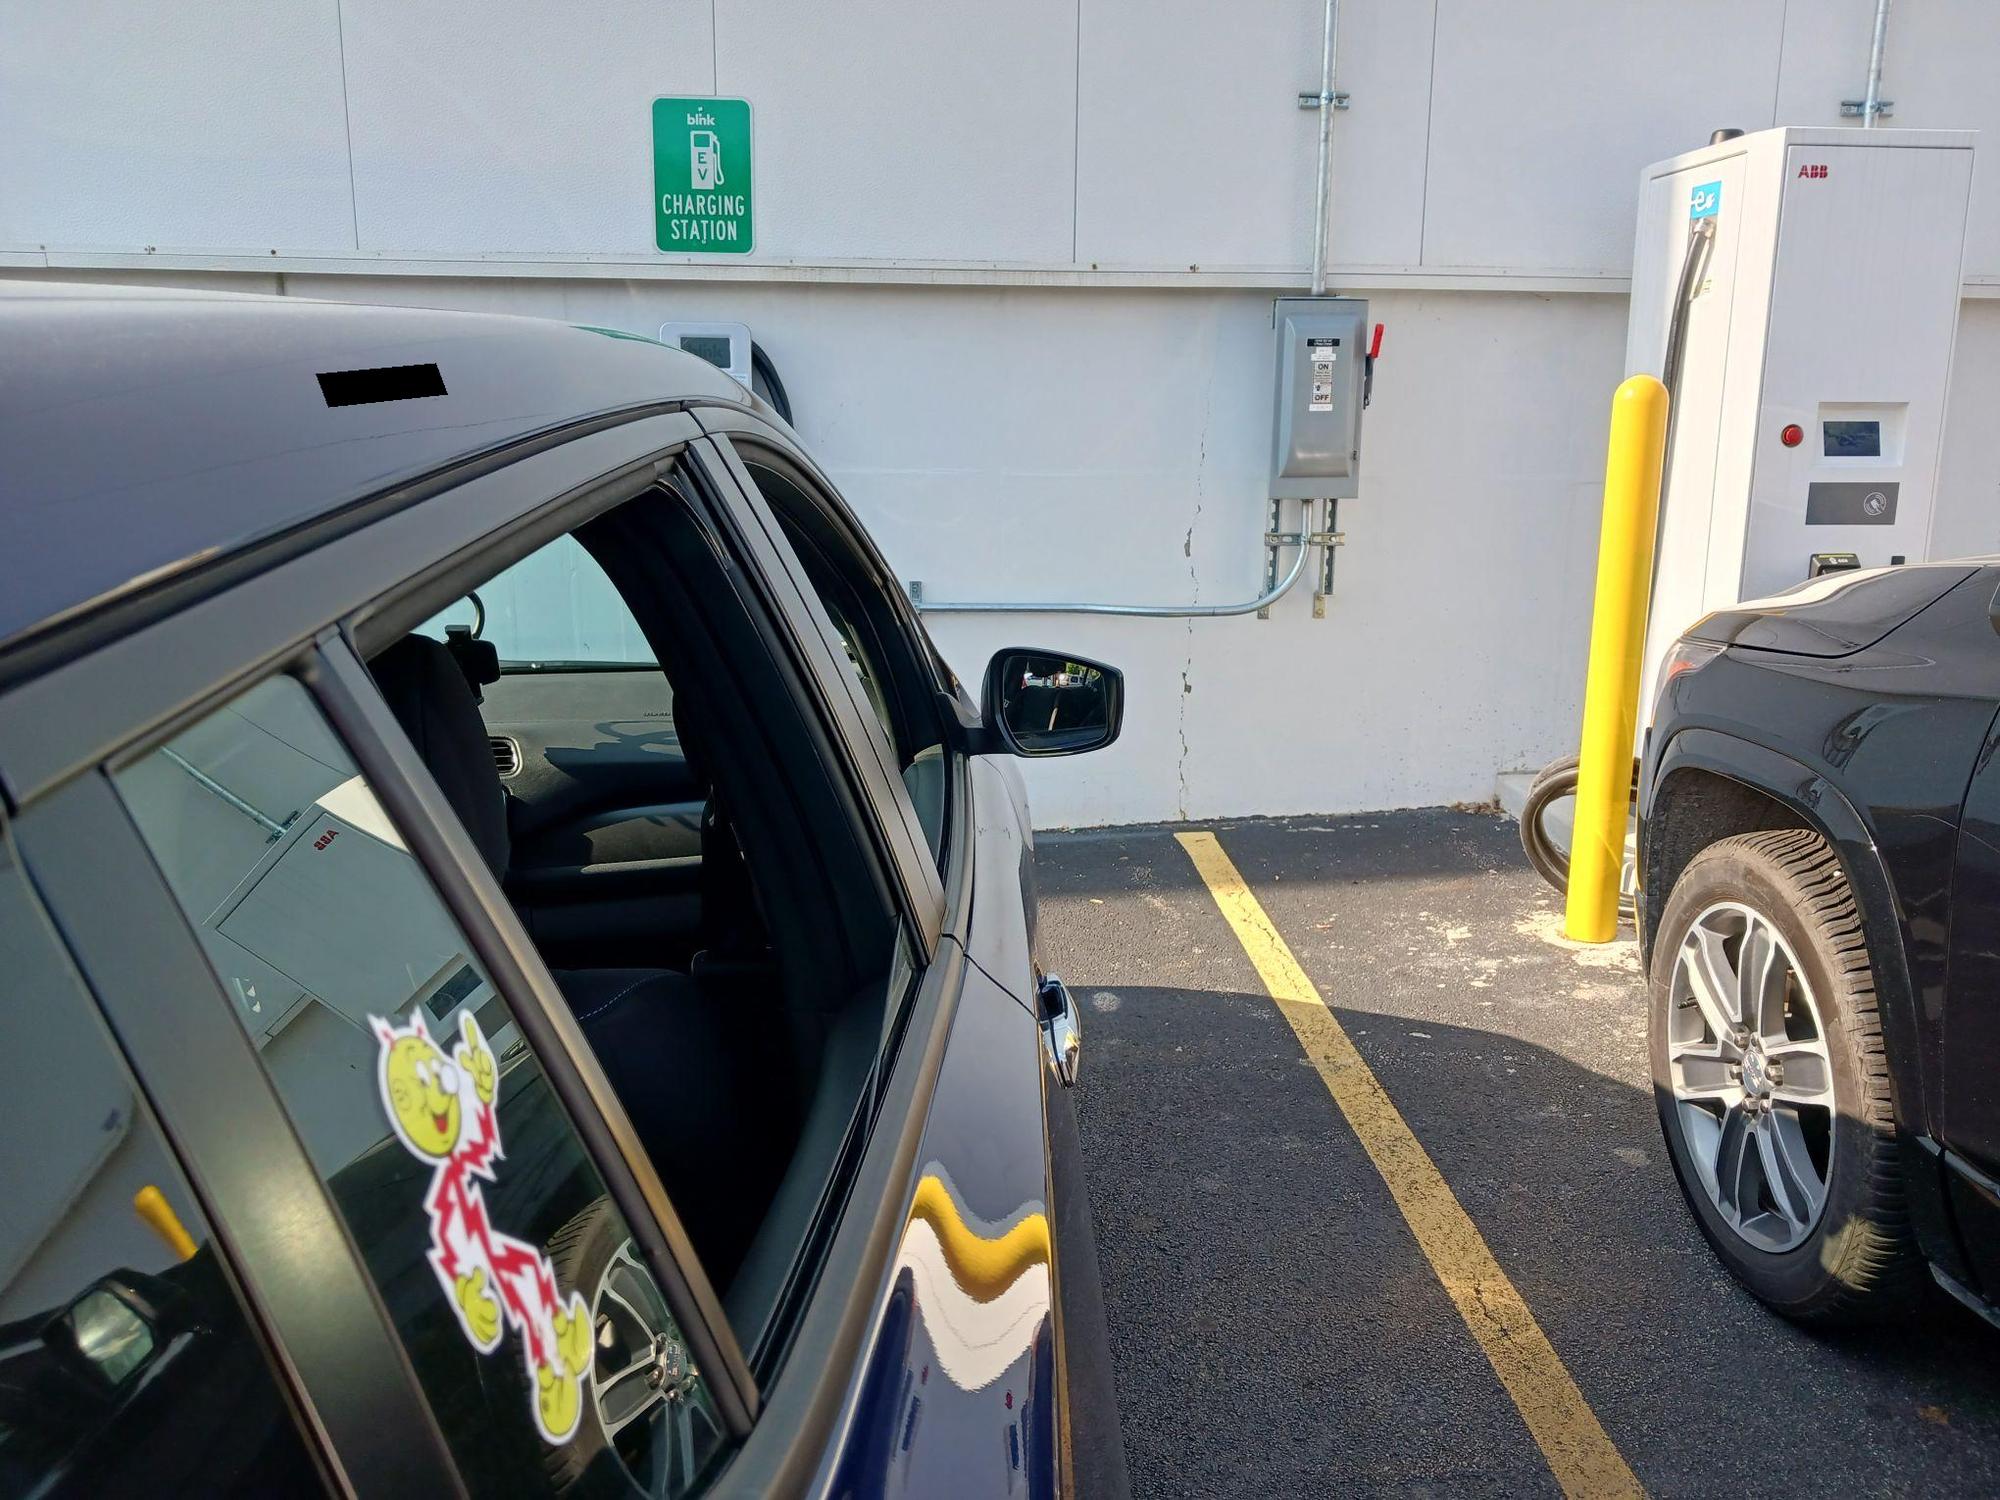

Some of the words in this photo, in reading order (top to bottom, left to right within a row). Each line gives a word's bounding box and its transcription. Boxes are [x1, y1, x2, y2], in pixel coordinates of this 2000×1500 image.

[687, 113, 715, 126] blink
[1798, 165, 1828, 178] ABB
[662, 194, 745, 216] CHARGING
[671, 219, 737, 241] STATION
